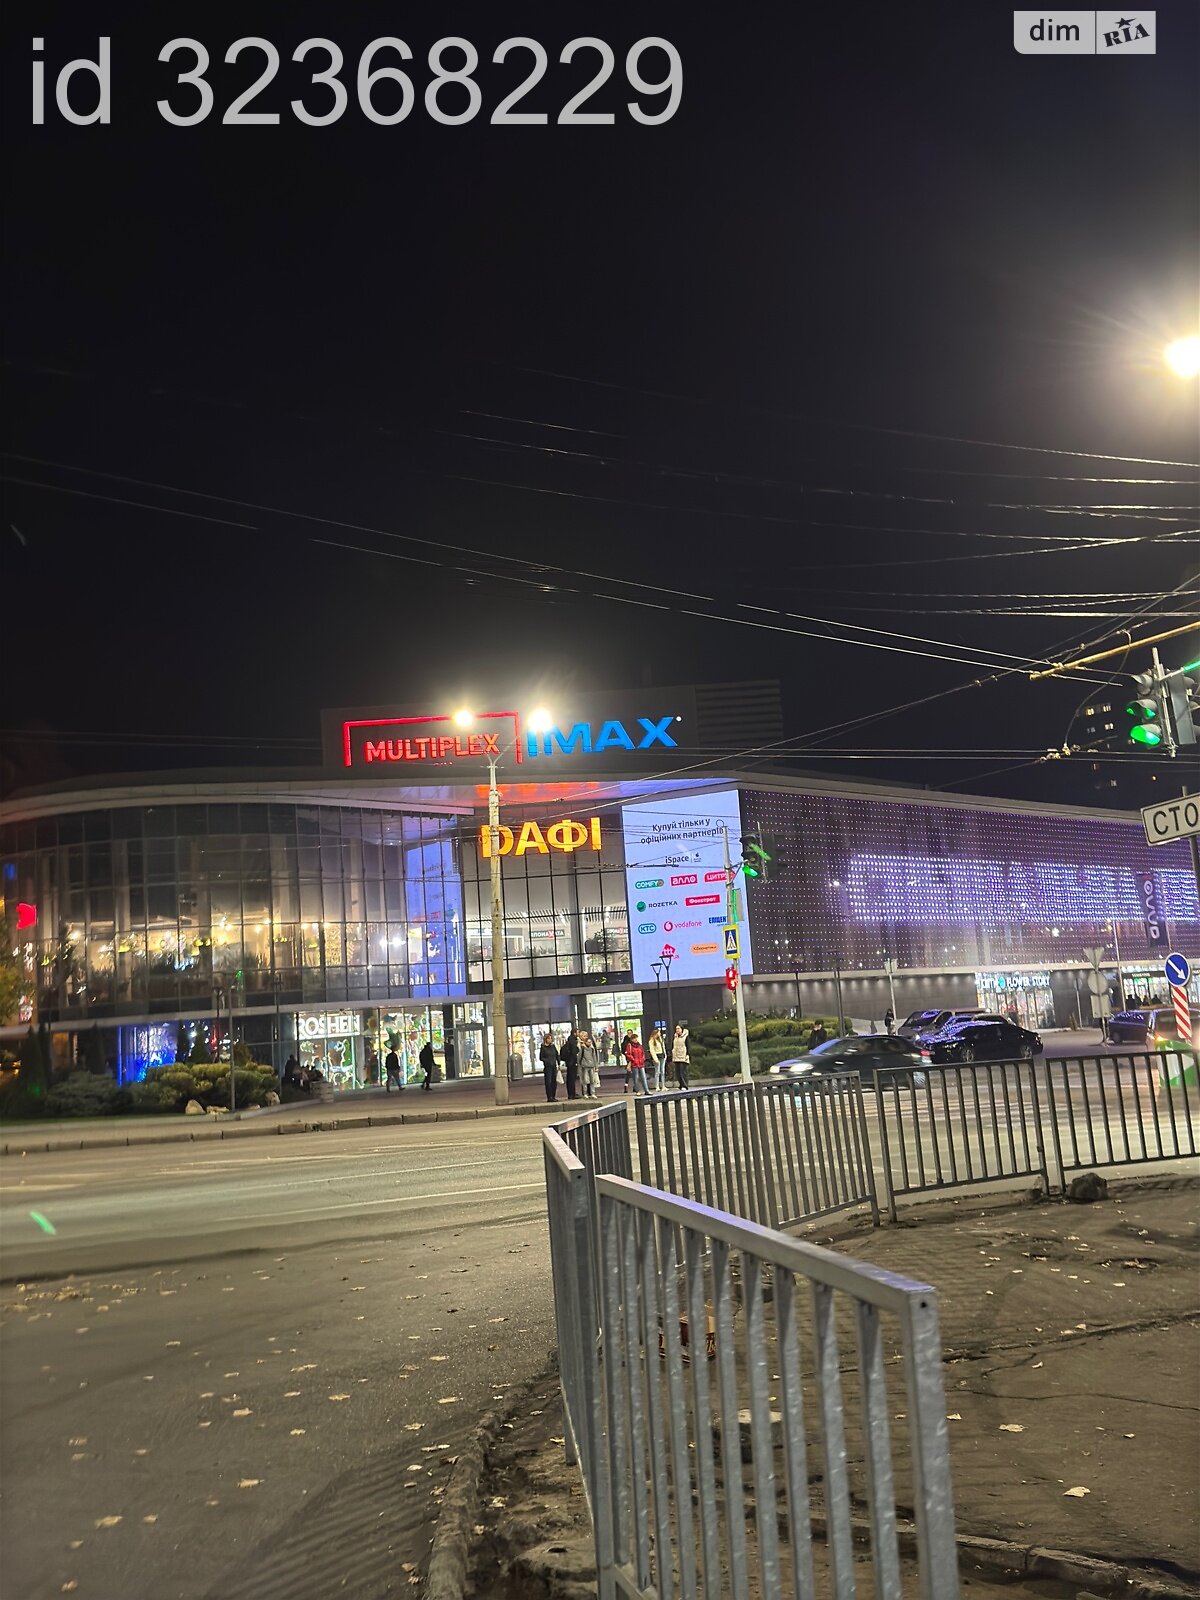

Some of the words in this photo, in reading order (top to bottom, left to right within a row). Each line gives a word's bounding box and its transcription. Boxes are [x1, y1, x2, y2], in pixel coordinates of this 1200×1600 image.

[527, 717, 678, 757] IMAX
[365, 734, 501, 763] MULTIPLEX
[652, 822, 677, 832] Купуй
[678, 819, 704, 828] тільки
[705, 818, 711, 826] у
[1153, 802, 1199, 835] СТО
[640, 833, 681, 844] офіційних
[665, 855, 689, 864] iSpace
[636, 880, 658, 888] COMFY
[674, 921, 702, 929] vodafone
[294, 1014, 361, 1036] ROSHEN
